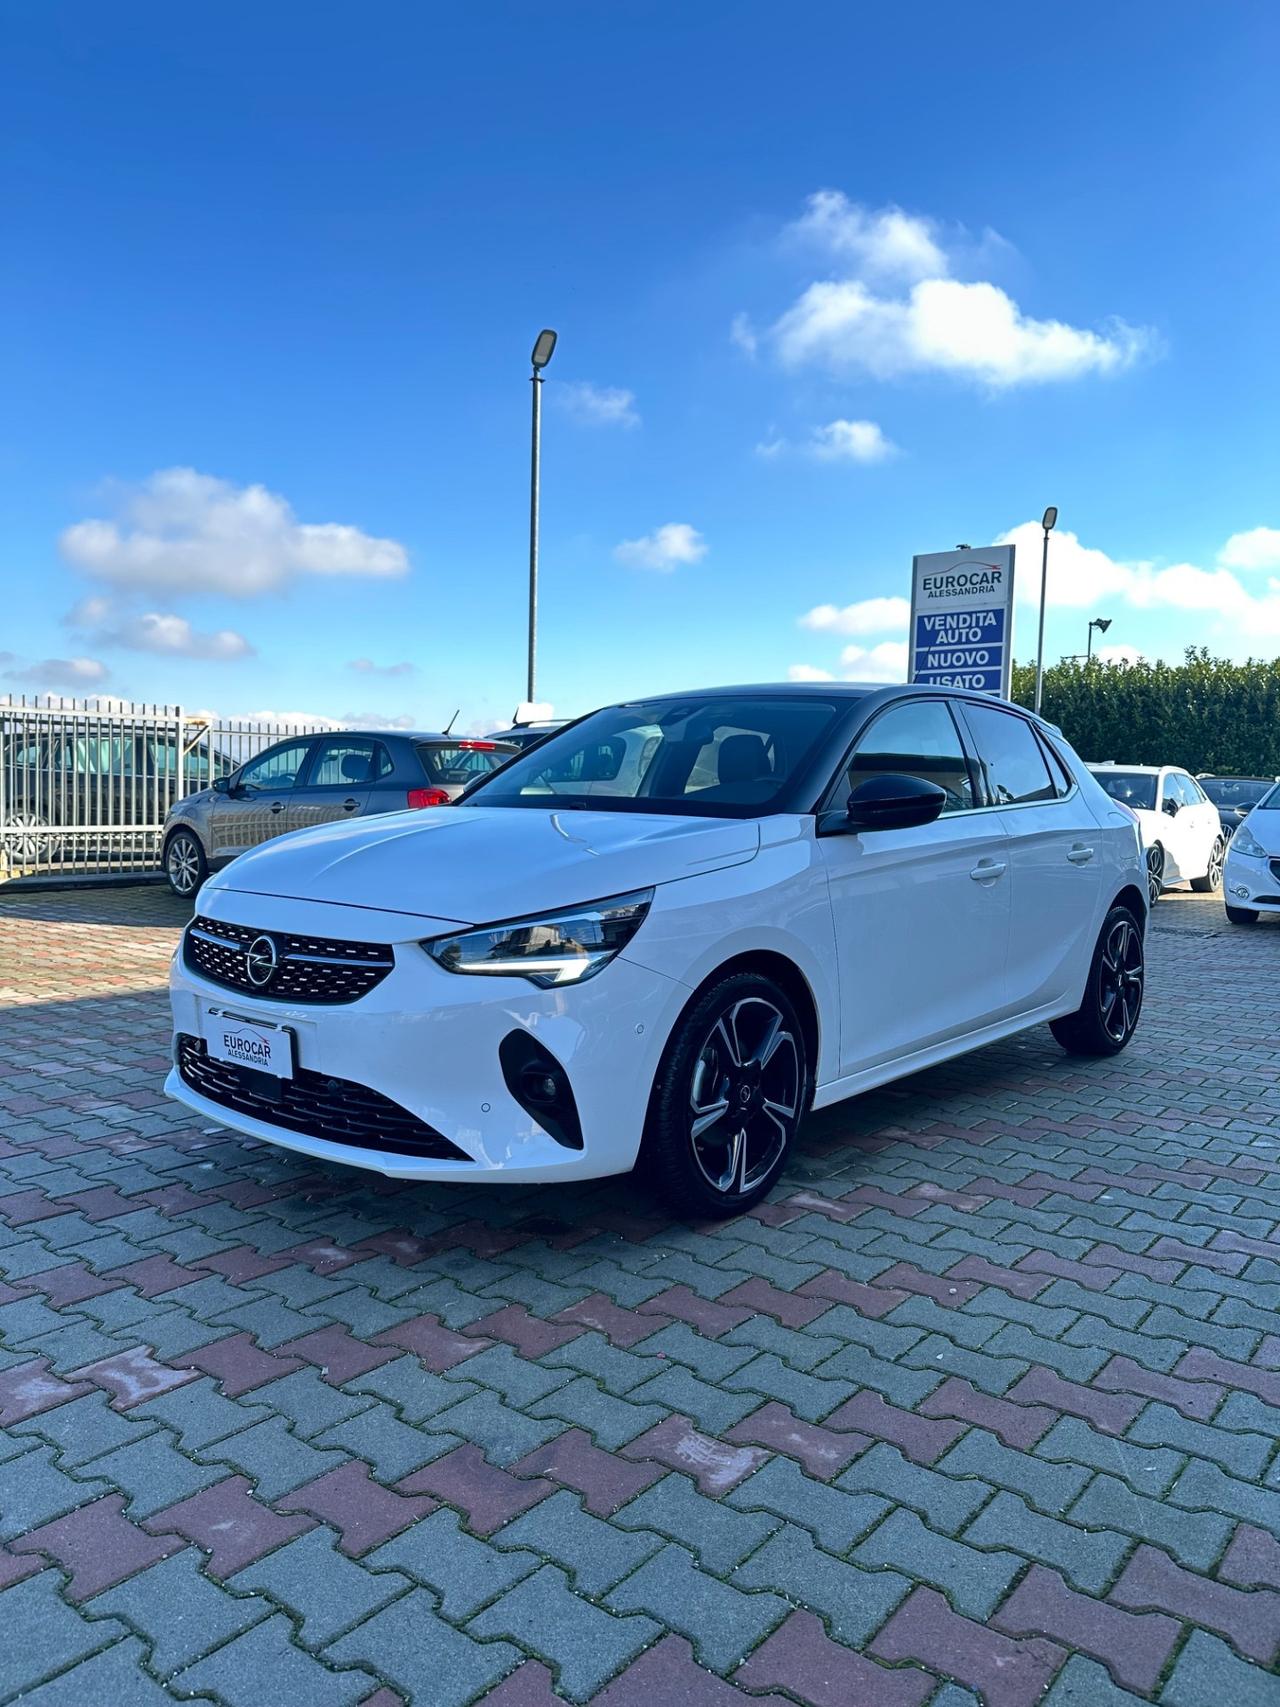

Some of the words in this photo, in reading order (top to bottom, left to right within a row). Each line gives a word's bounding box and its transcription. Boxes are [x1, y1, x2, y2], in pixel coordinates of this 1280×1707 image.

[923, 571, 1002, 591] EUROCAR
[928, 585, 995, 598] ALESSANDRIA
[924, 612, 997, 630] VENDITA
[936, 628, 982, 644] AUTO
[927, 650, 989, 668] NUOVO
[929, 674, 985, 688] USATO
[223, 1034, 271, 1058] EUROCAR
[228, 1049, 269, 1066] ALESSANDRIA
